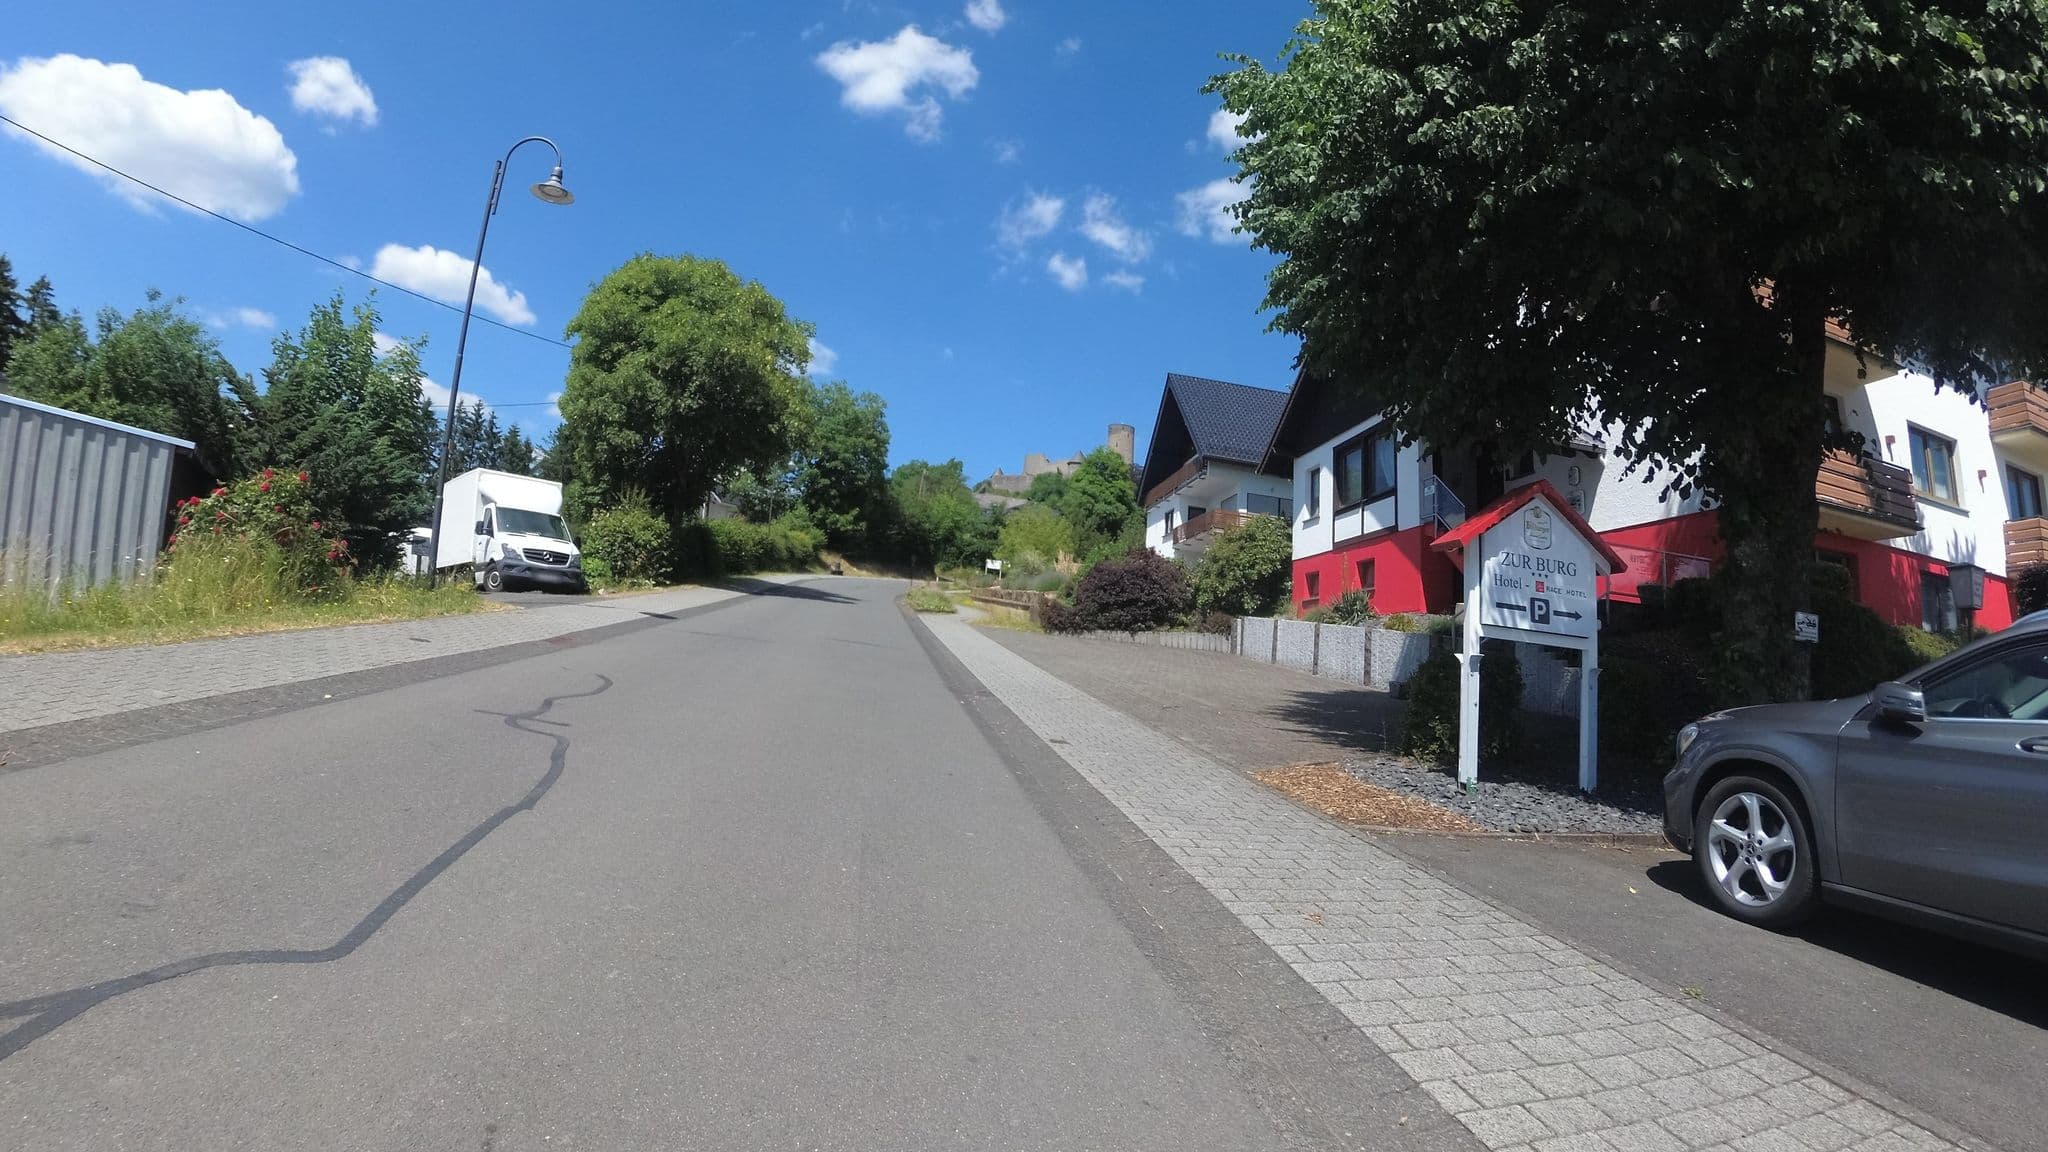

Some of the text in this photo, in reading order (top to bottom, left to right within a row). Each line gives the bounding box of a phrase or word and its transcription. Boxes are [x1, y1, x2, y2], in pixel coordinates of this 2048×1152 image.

[1501, 552, 1577, 577] ZUR BURG
[1494, 573, 1522, 589] Hotel
[1566, 589, 1588, 599] HOTEL
[1534, 600, 1547, 621] P
